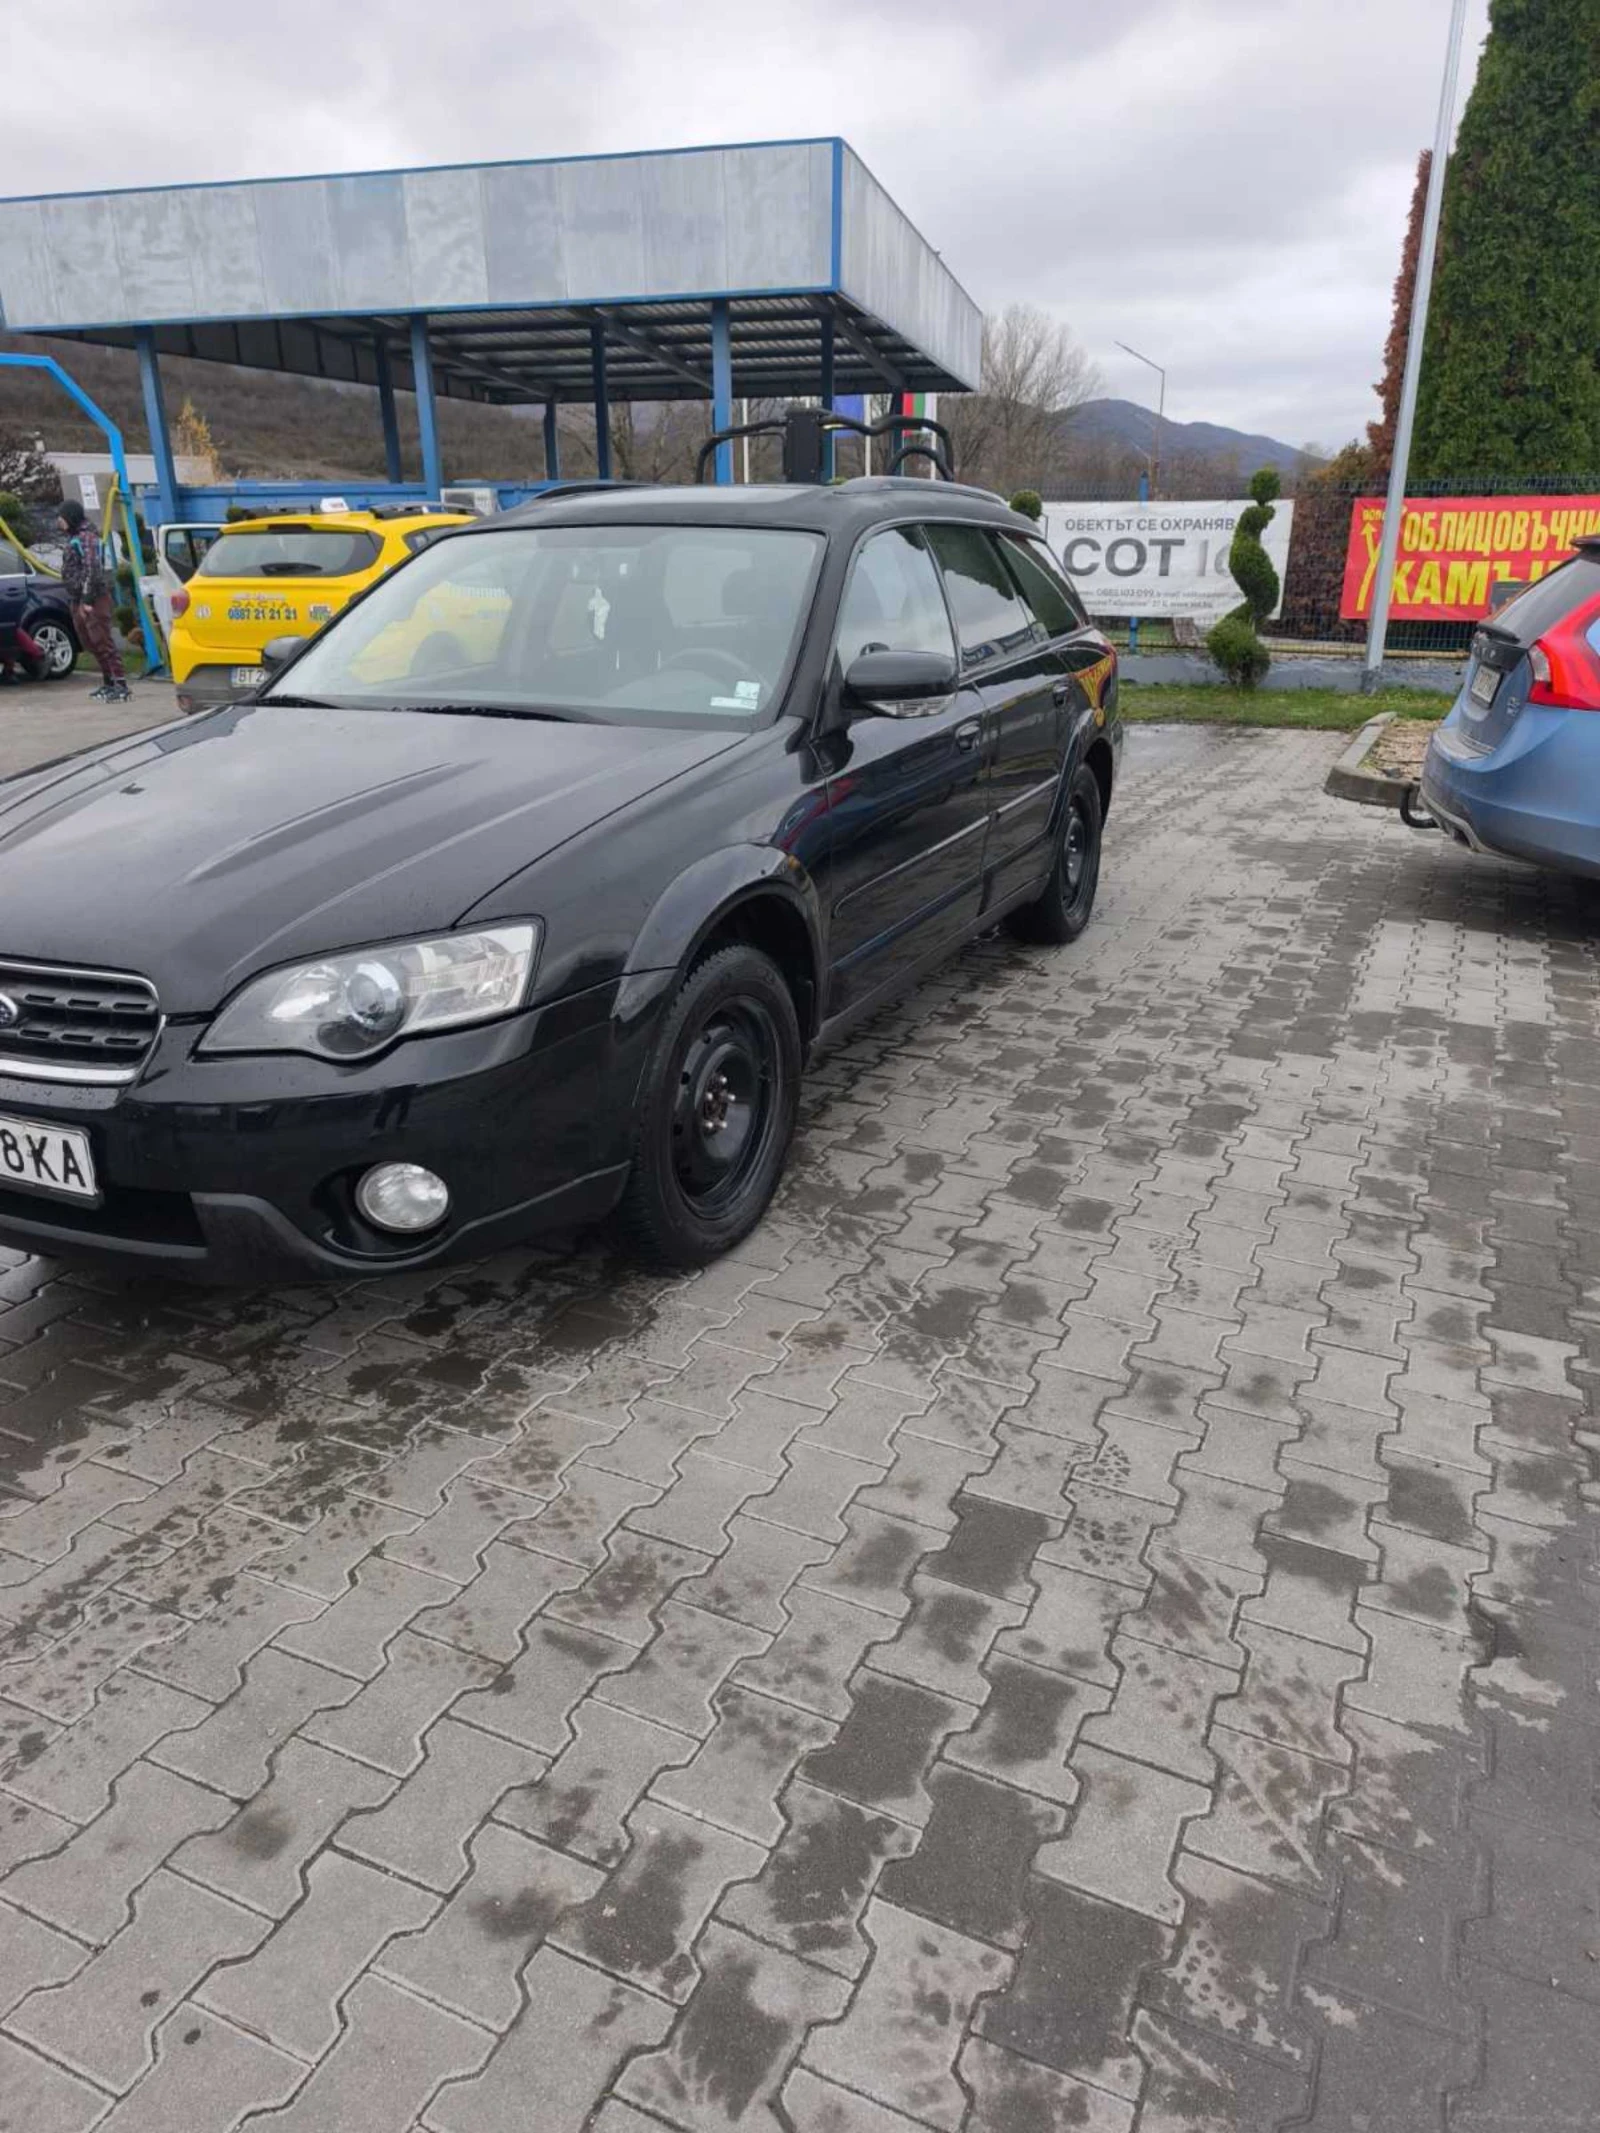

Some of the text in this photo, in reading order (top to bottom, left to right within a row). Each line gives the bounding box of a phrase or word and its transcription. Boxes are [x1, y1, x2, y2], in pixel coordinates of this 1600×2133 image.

[1064, 517, 1235, 532] ОБЕКТЪТ СЕ ОХРАНЯВ
[1062, 537, 1185, 577] СОТ
[255, 669, 265, 682] 2
